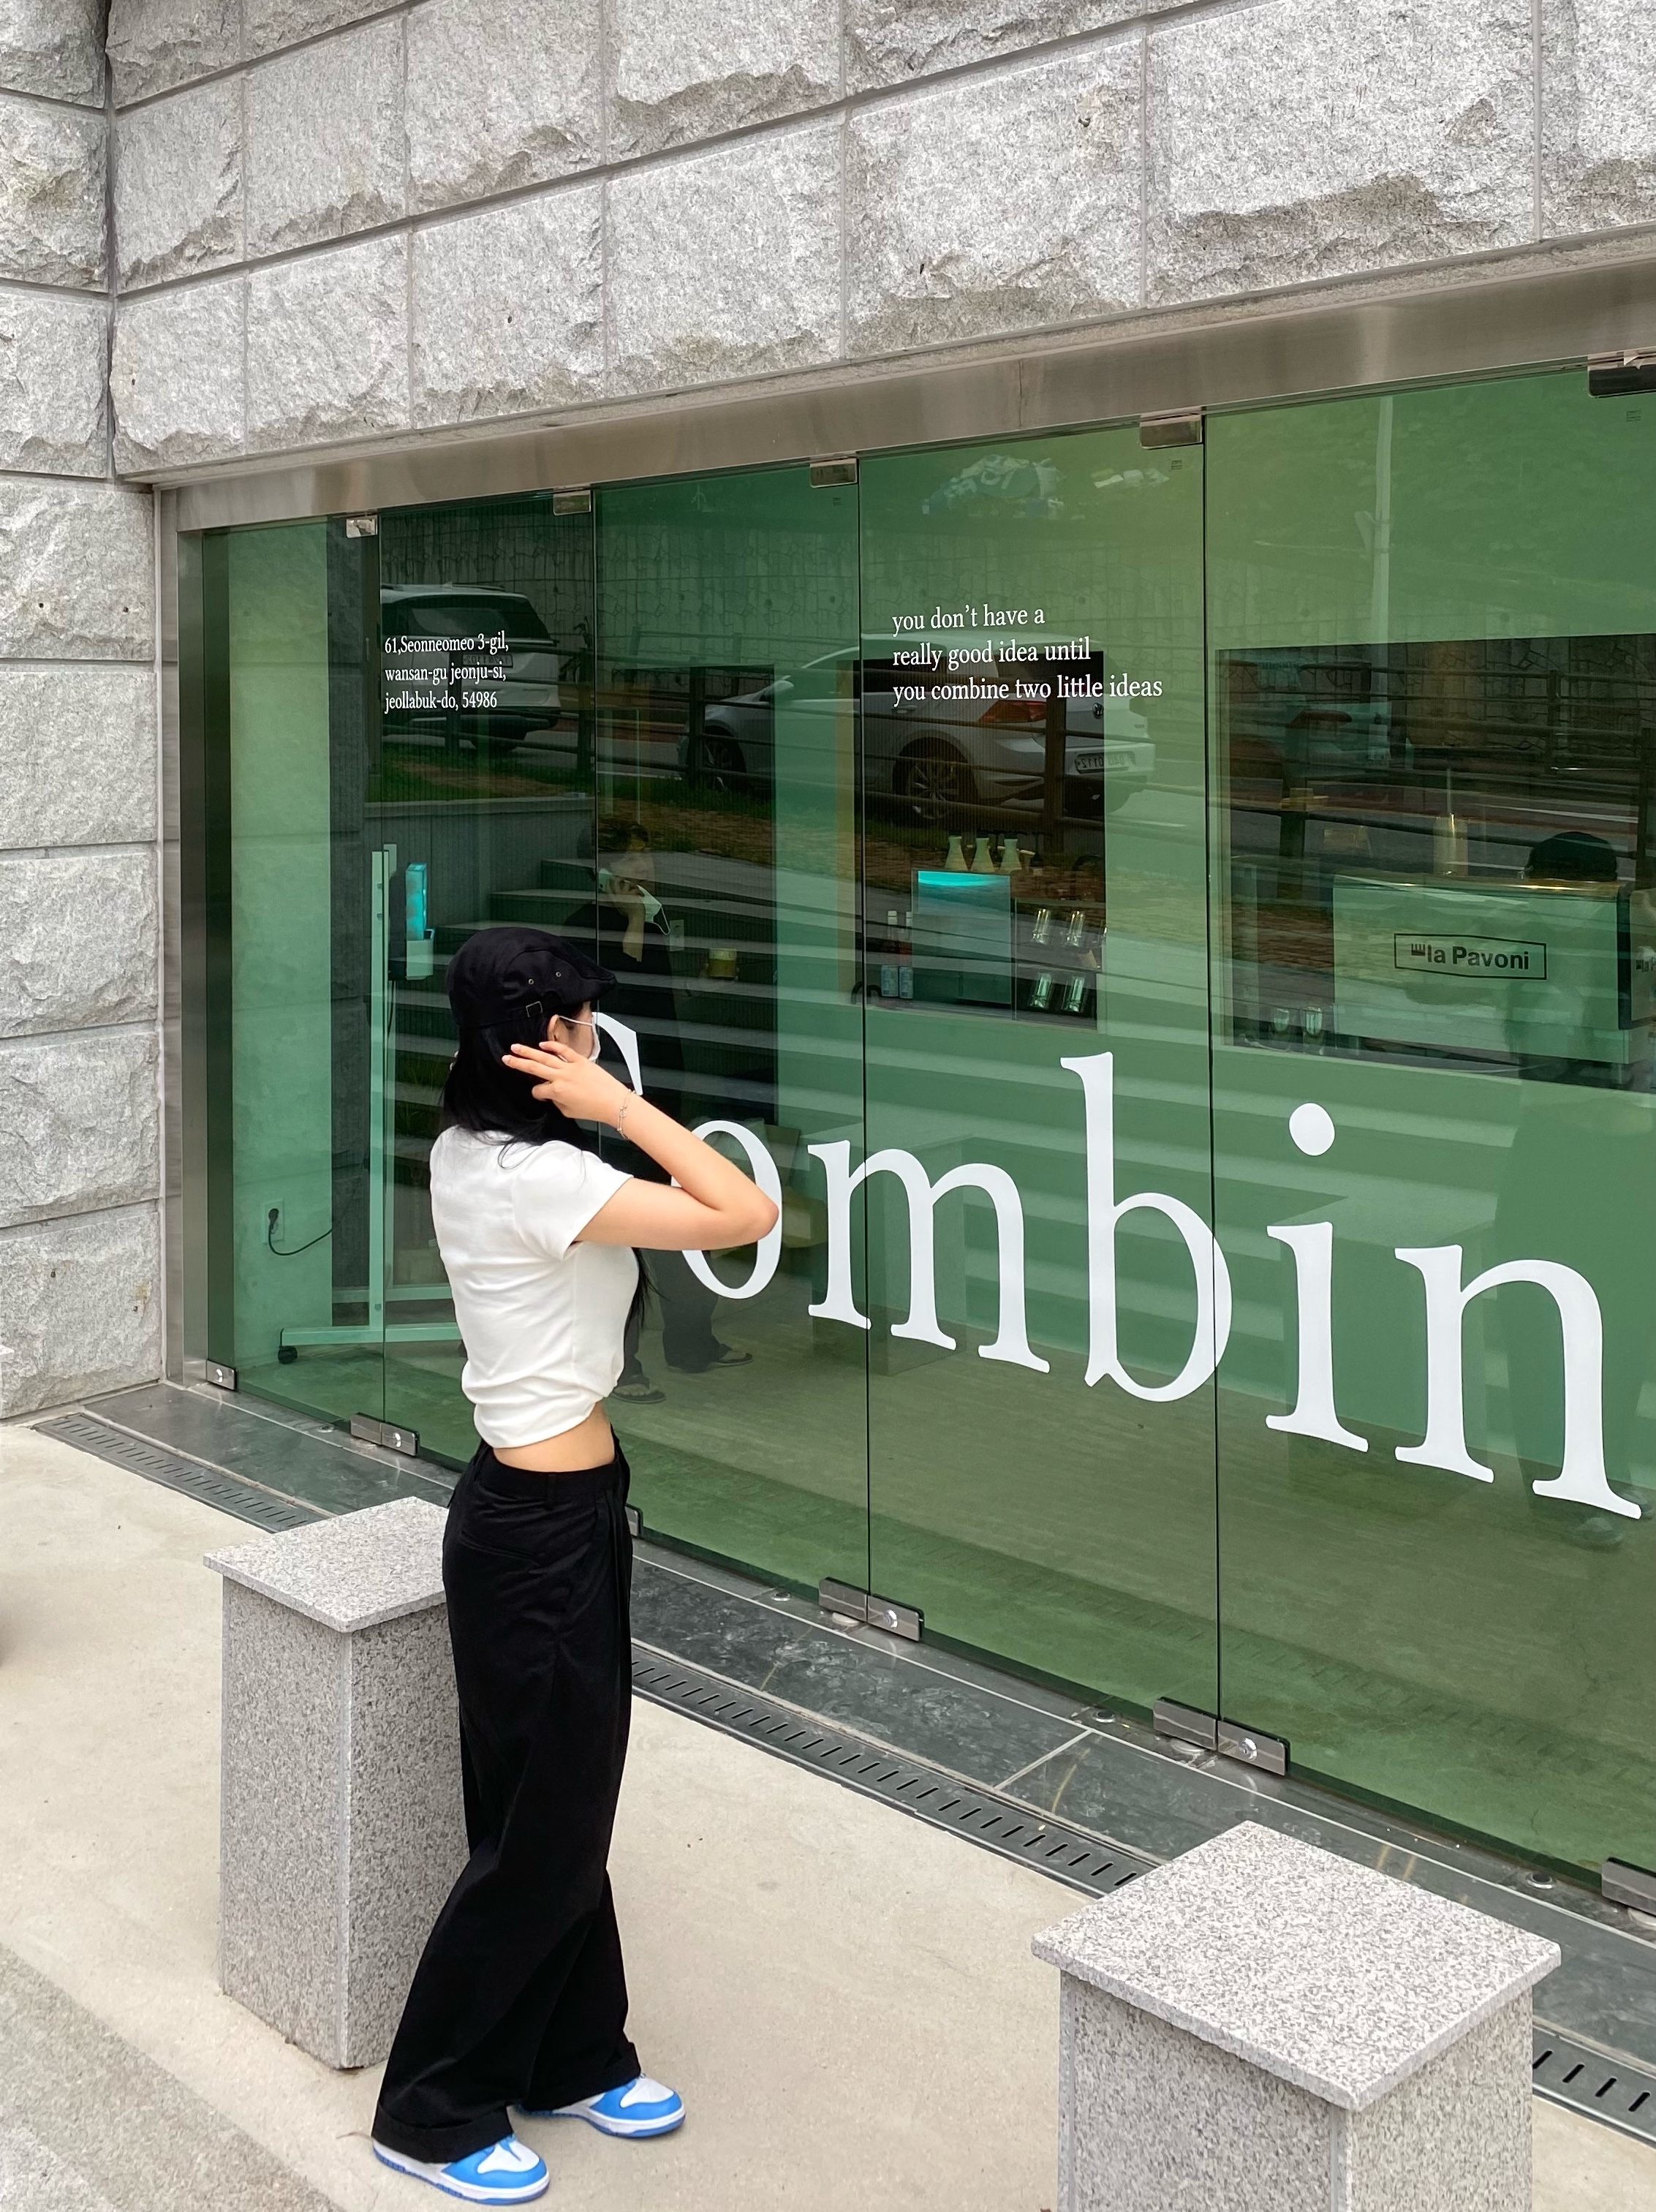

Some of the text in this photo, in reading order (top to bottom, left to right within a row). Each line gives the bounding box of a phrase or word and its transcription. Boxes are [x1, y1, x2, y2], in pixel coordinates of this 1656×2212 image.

[892, 615, 925, 638] you
[983, 603, 1028, 627] have
[1034, 608, 1046, 624] a
[385, 630, 509, 656] 61,Seonneomeo 3-gil,
[893, 635, 1091, 671] really good idea until
[385, 660, 506, 686] wansan-gu jeonju-si,
[384, 690, 497, 714] jeollabuk-do, 54986
[893, 673, 1162, 707] you combine two little ideas
[1428, 944, 1530, 970] la Pavoni
[593, 1011, 1642, 1520] ombin
